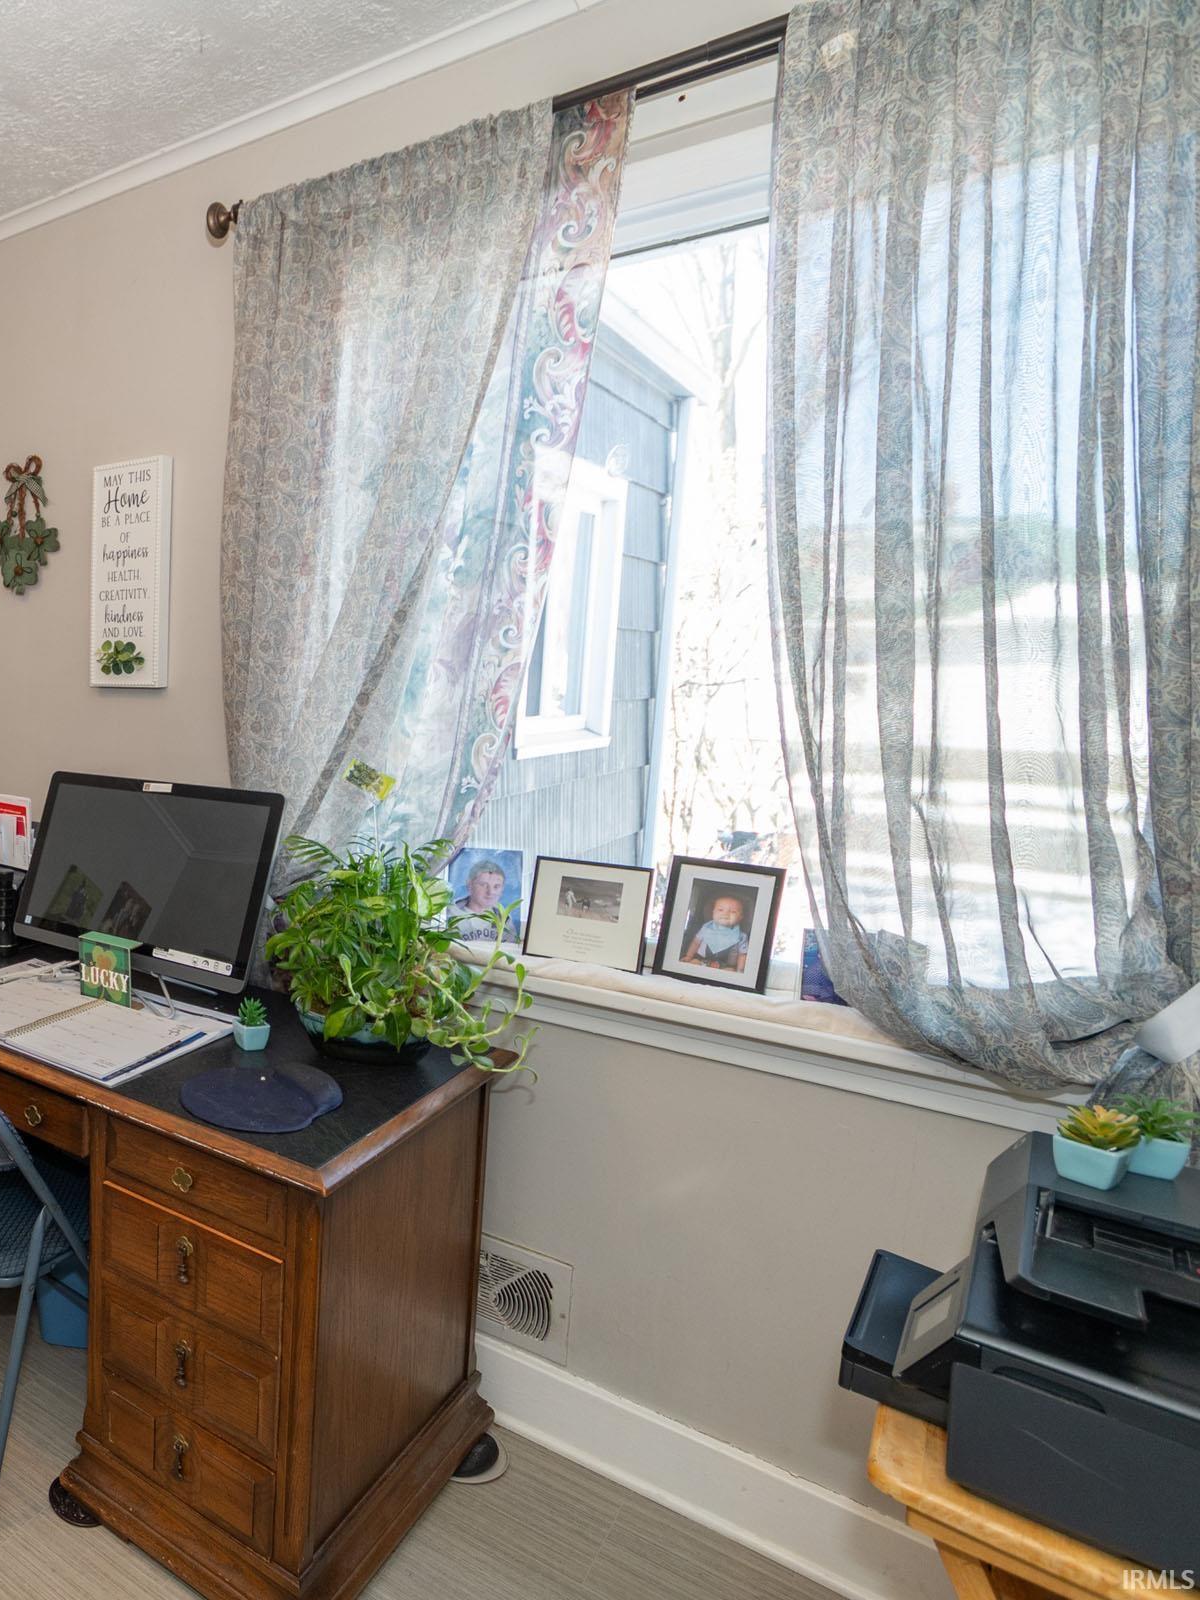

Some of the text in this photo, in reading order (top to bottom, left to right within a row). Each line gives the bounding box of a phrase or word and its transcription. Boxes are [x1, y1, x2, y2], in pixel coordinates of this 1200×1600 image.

[103, 468, 152, 488] MAY THIS
[103, 486, 150, 514] Home
[101, 510, 151, 528] BE A PLACE
[119, 531, 131, 543] OF
[102, 543, 149, 568] happiness
[104, 603, 144, 624] kindness
[102, 626, 120, 638] AND
[80, 962, 130, 993] LUCKY
